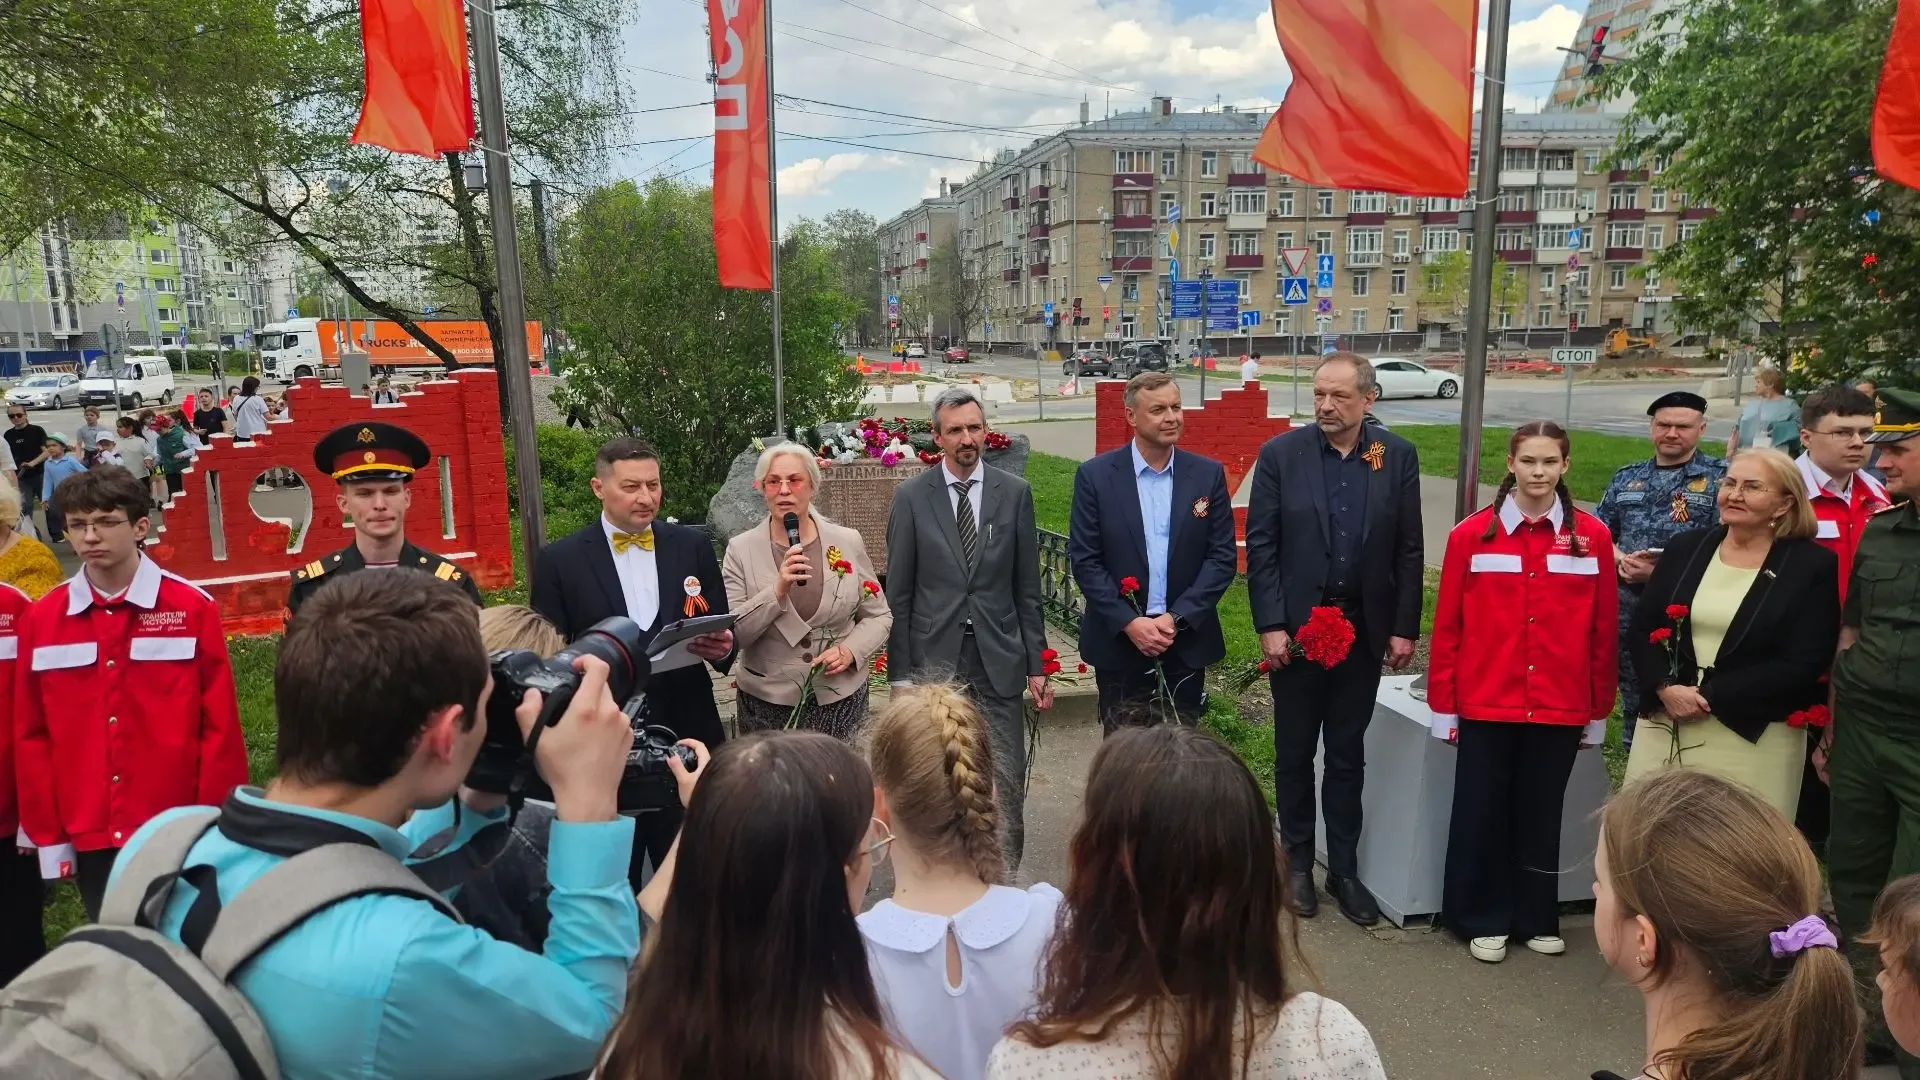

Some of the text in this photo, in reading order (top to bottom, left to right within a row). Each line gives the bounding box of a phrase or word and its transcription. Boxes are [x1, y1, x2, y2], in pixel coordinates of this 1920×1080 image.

[1556, 350, 1592, 361] СТОП
[821, 467, 876, 479] РАНАМ
[139, 611, 186, 620] ХРАНИТЕЛИ
